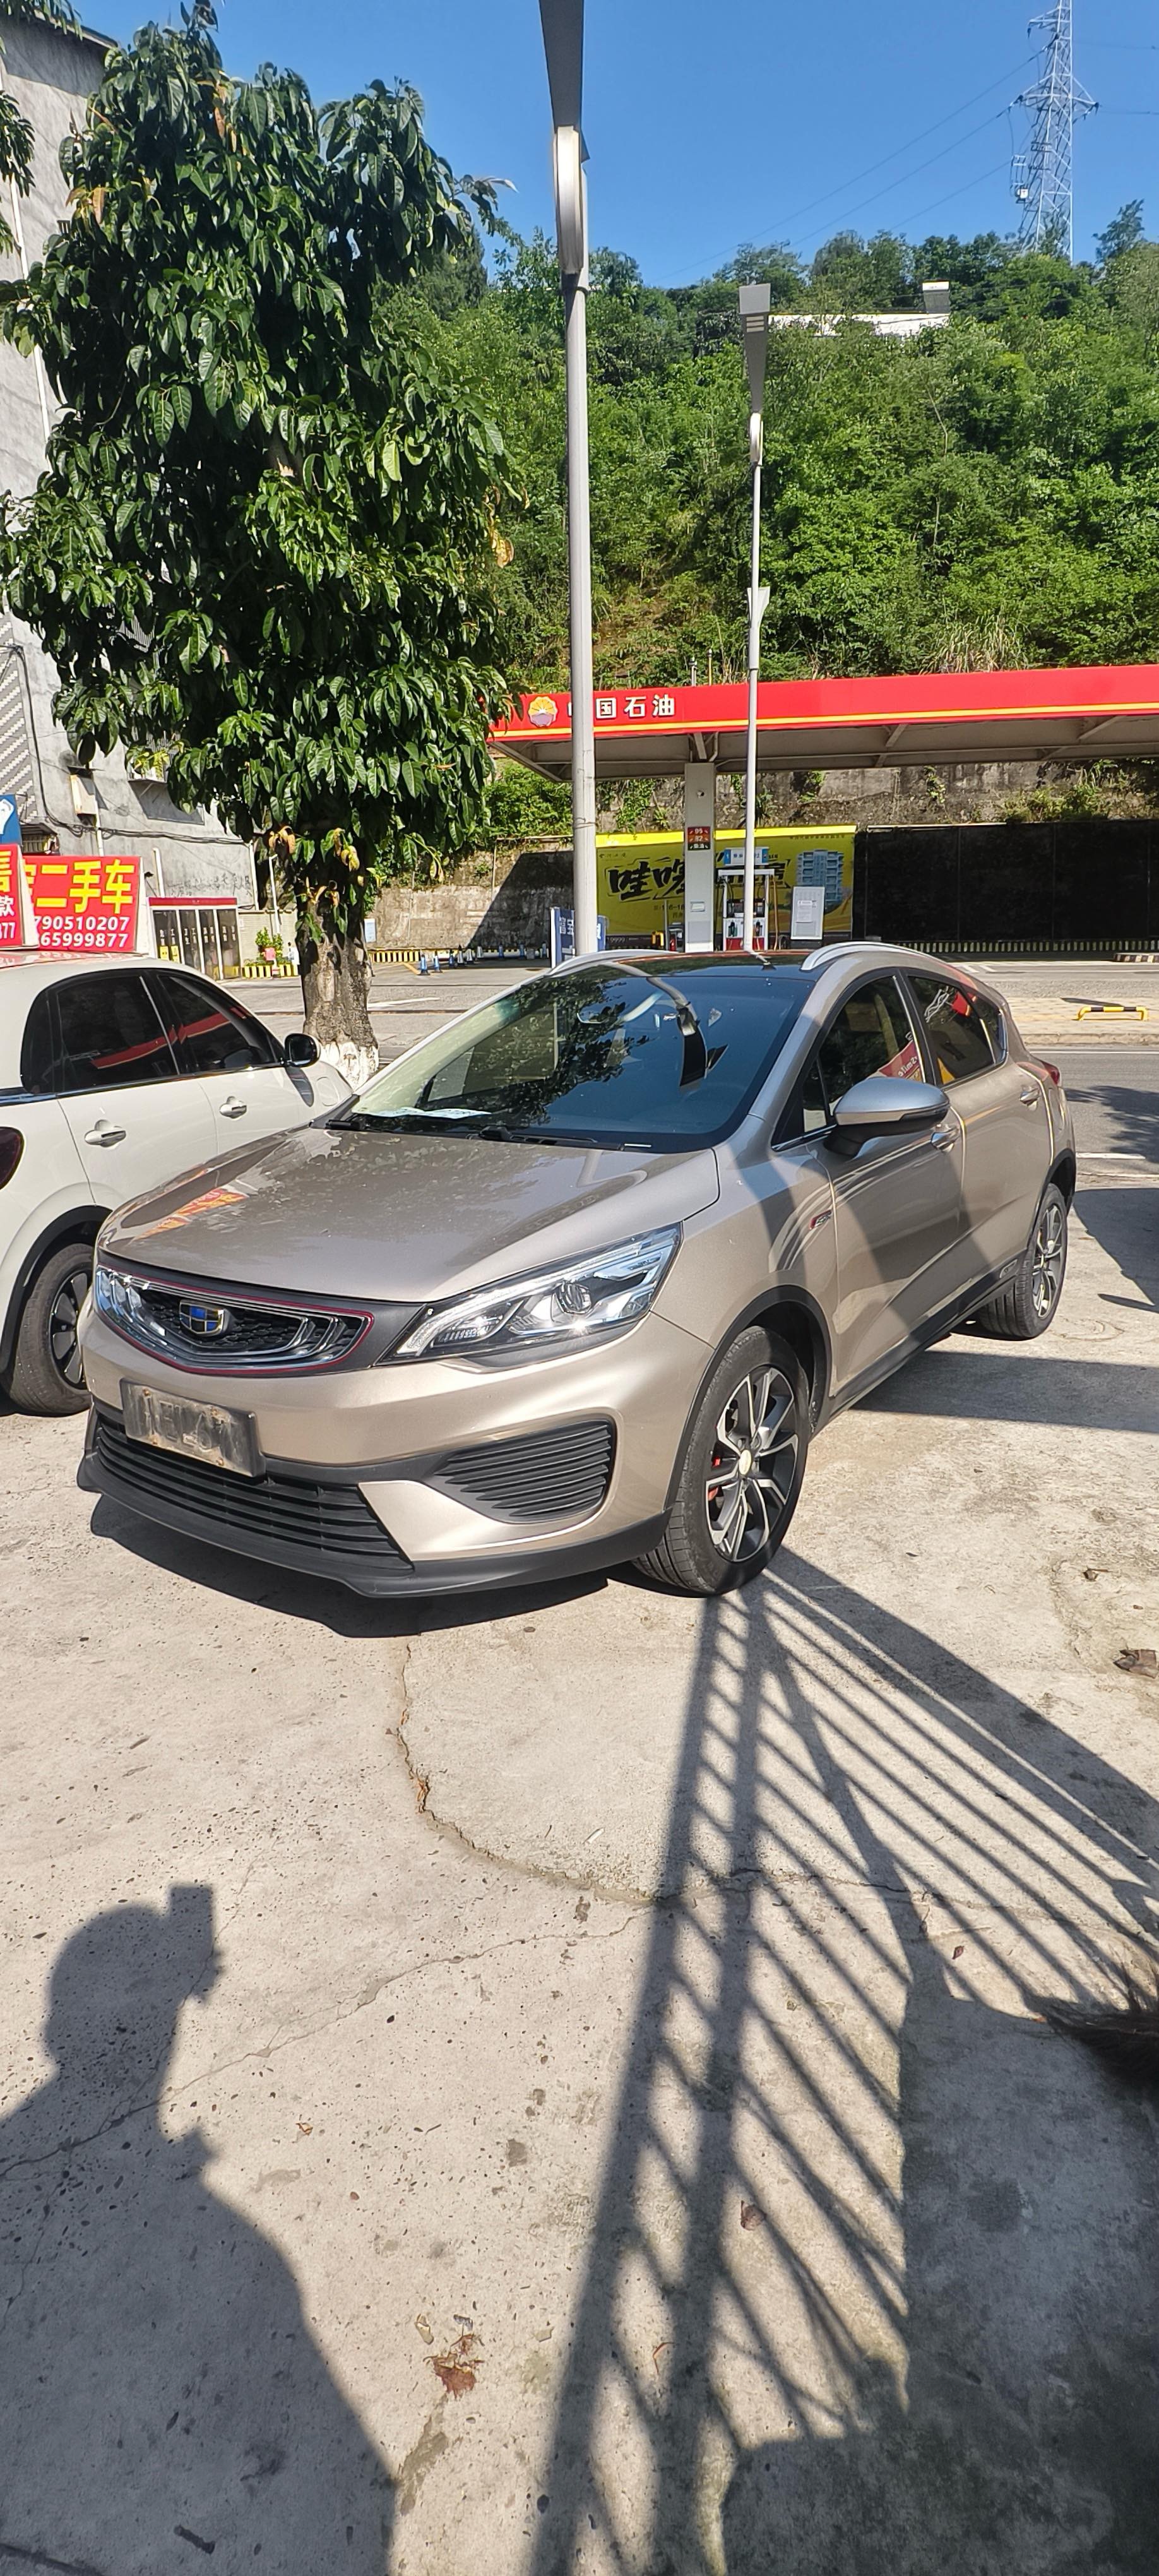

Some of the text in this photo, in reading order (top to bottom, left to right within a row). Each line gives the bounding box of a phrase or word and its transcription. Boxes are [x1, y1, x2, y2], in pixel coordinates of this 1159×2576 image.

[568, 694, 675, 719] 国石油
[40, 933, 129, 947] 65999877
